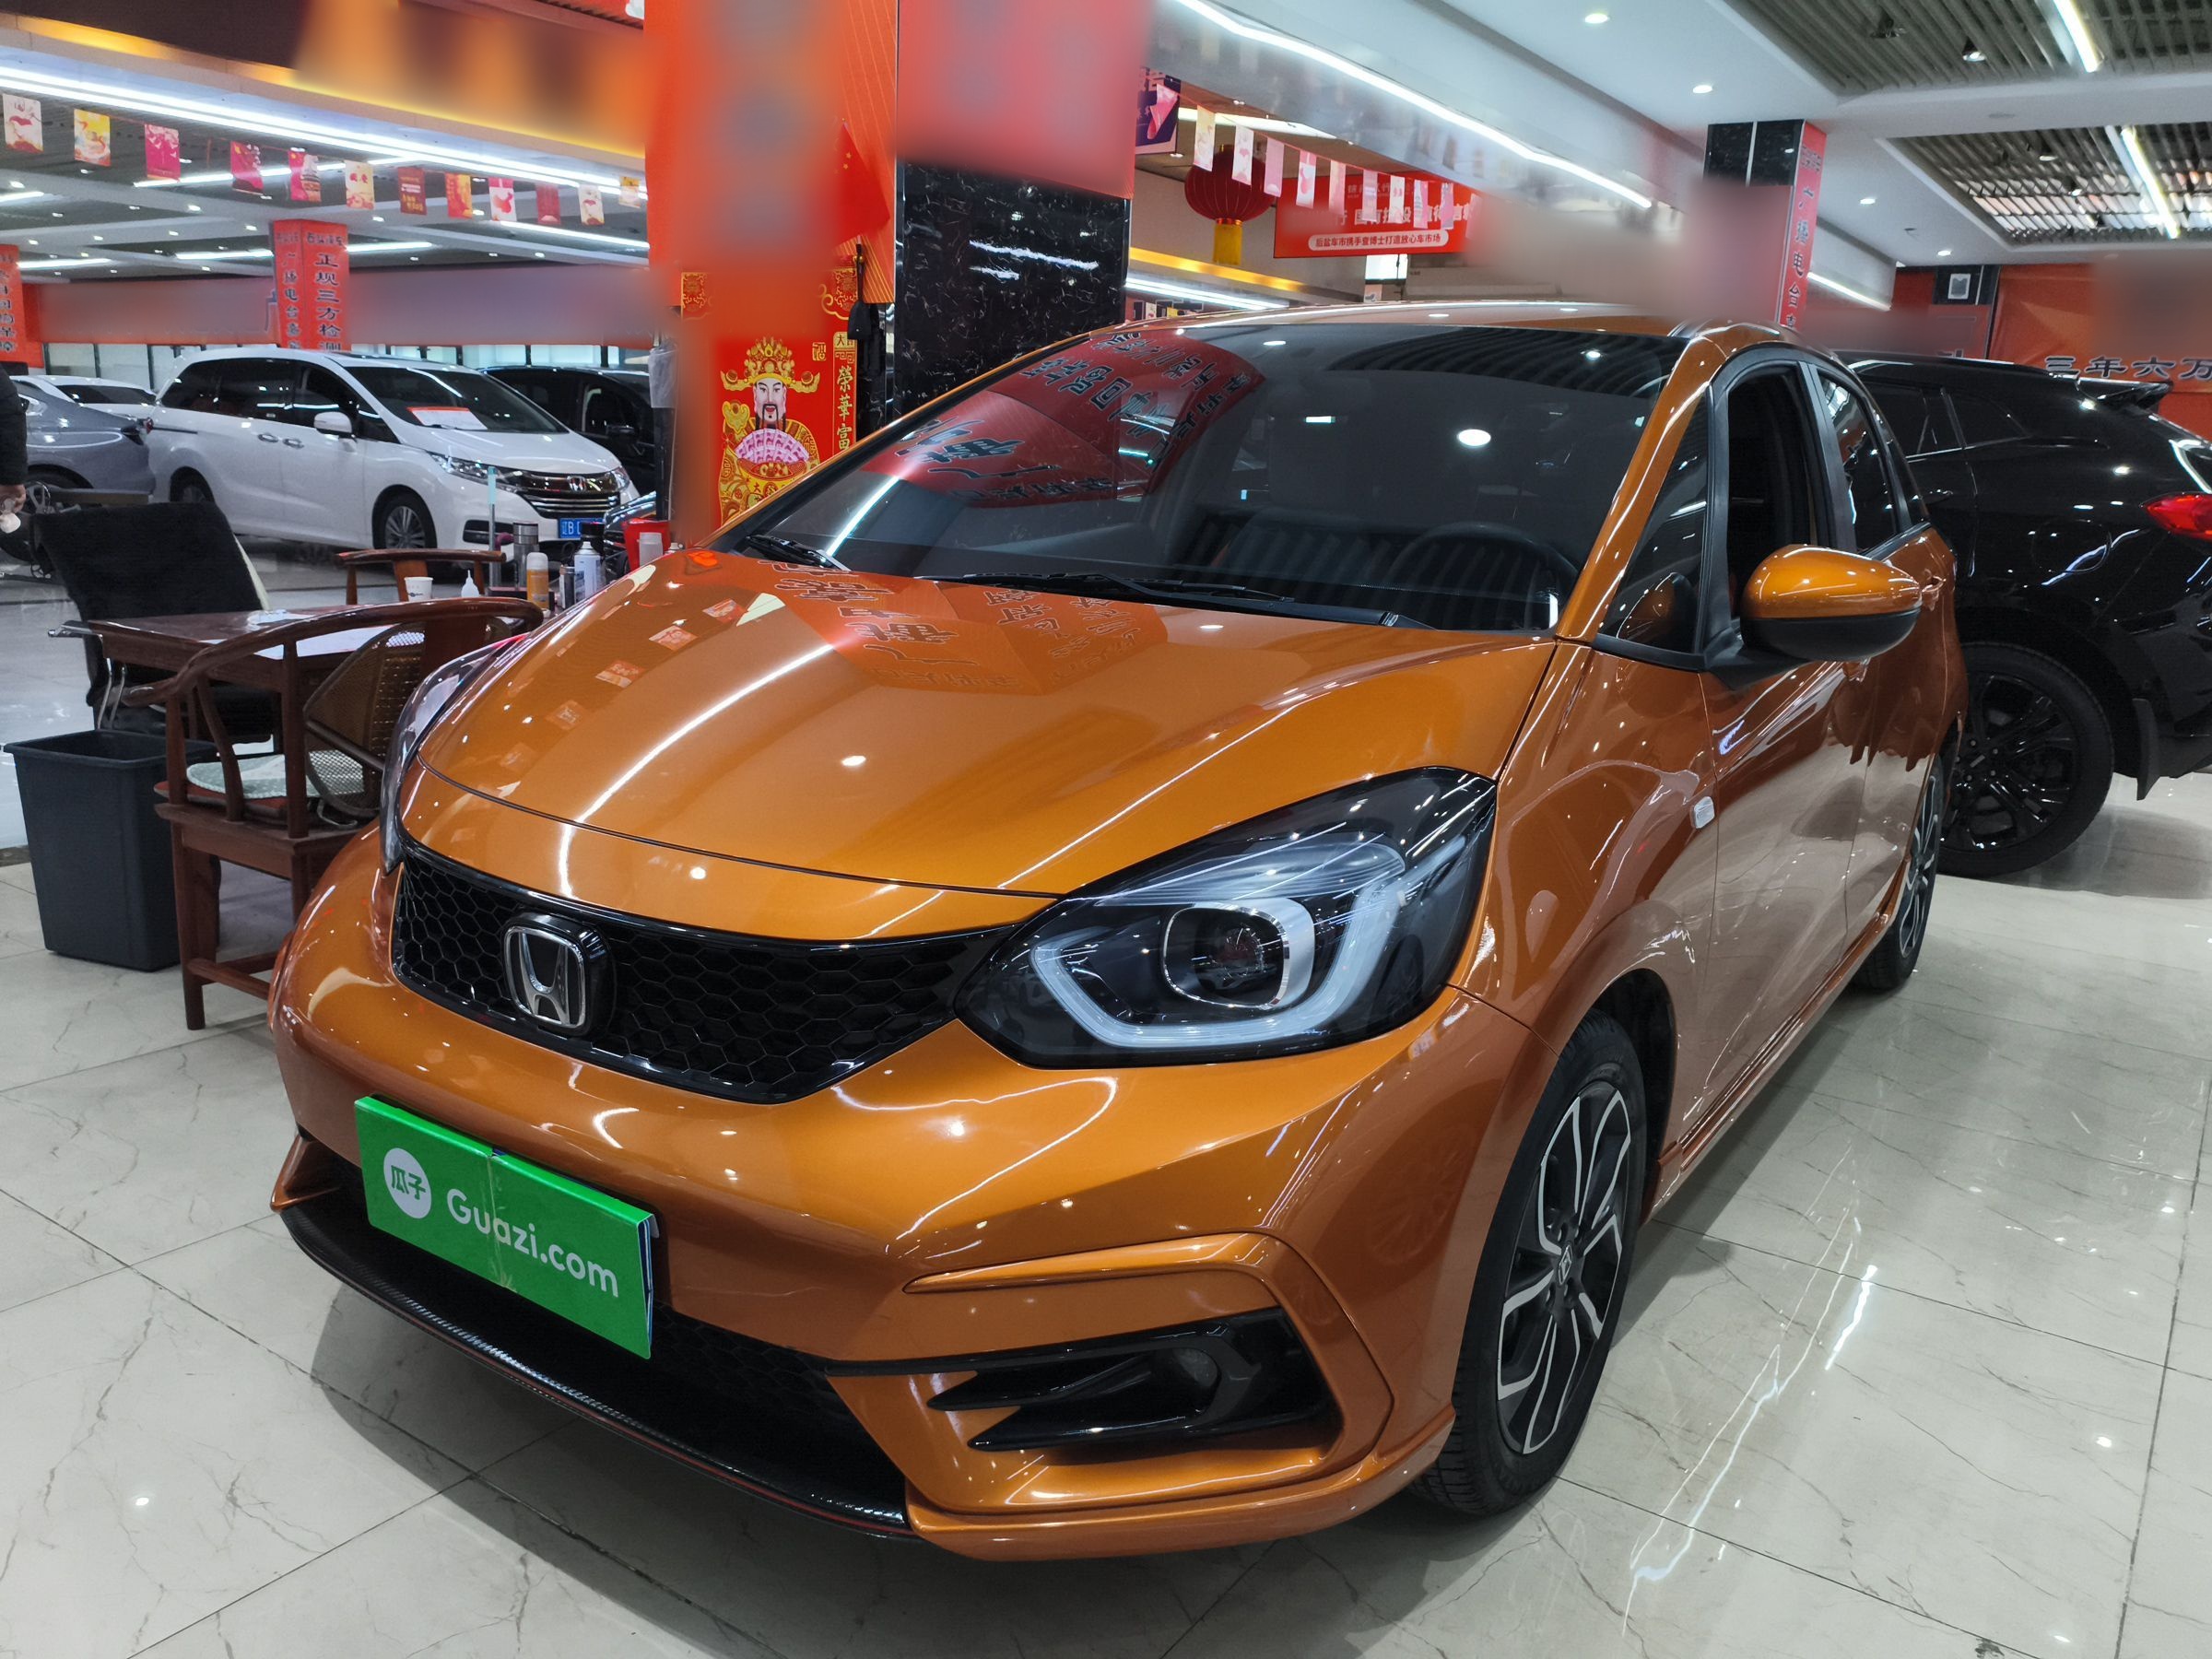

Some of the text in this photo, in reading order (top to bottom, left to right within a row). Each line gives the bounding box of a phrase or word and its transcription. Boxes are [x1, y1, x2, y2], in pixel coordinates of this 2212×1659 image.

[314, 253, 342, 351] 正规三方检测
[2045, 355, 2212, 380] 三年六万
[391, 1165, 427, 1200] 瓜子
[447, 1189, 618, 1298] Guazi.com
